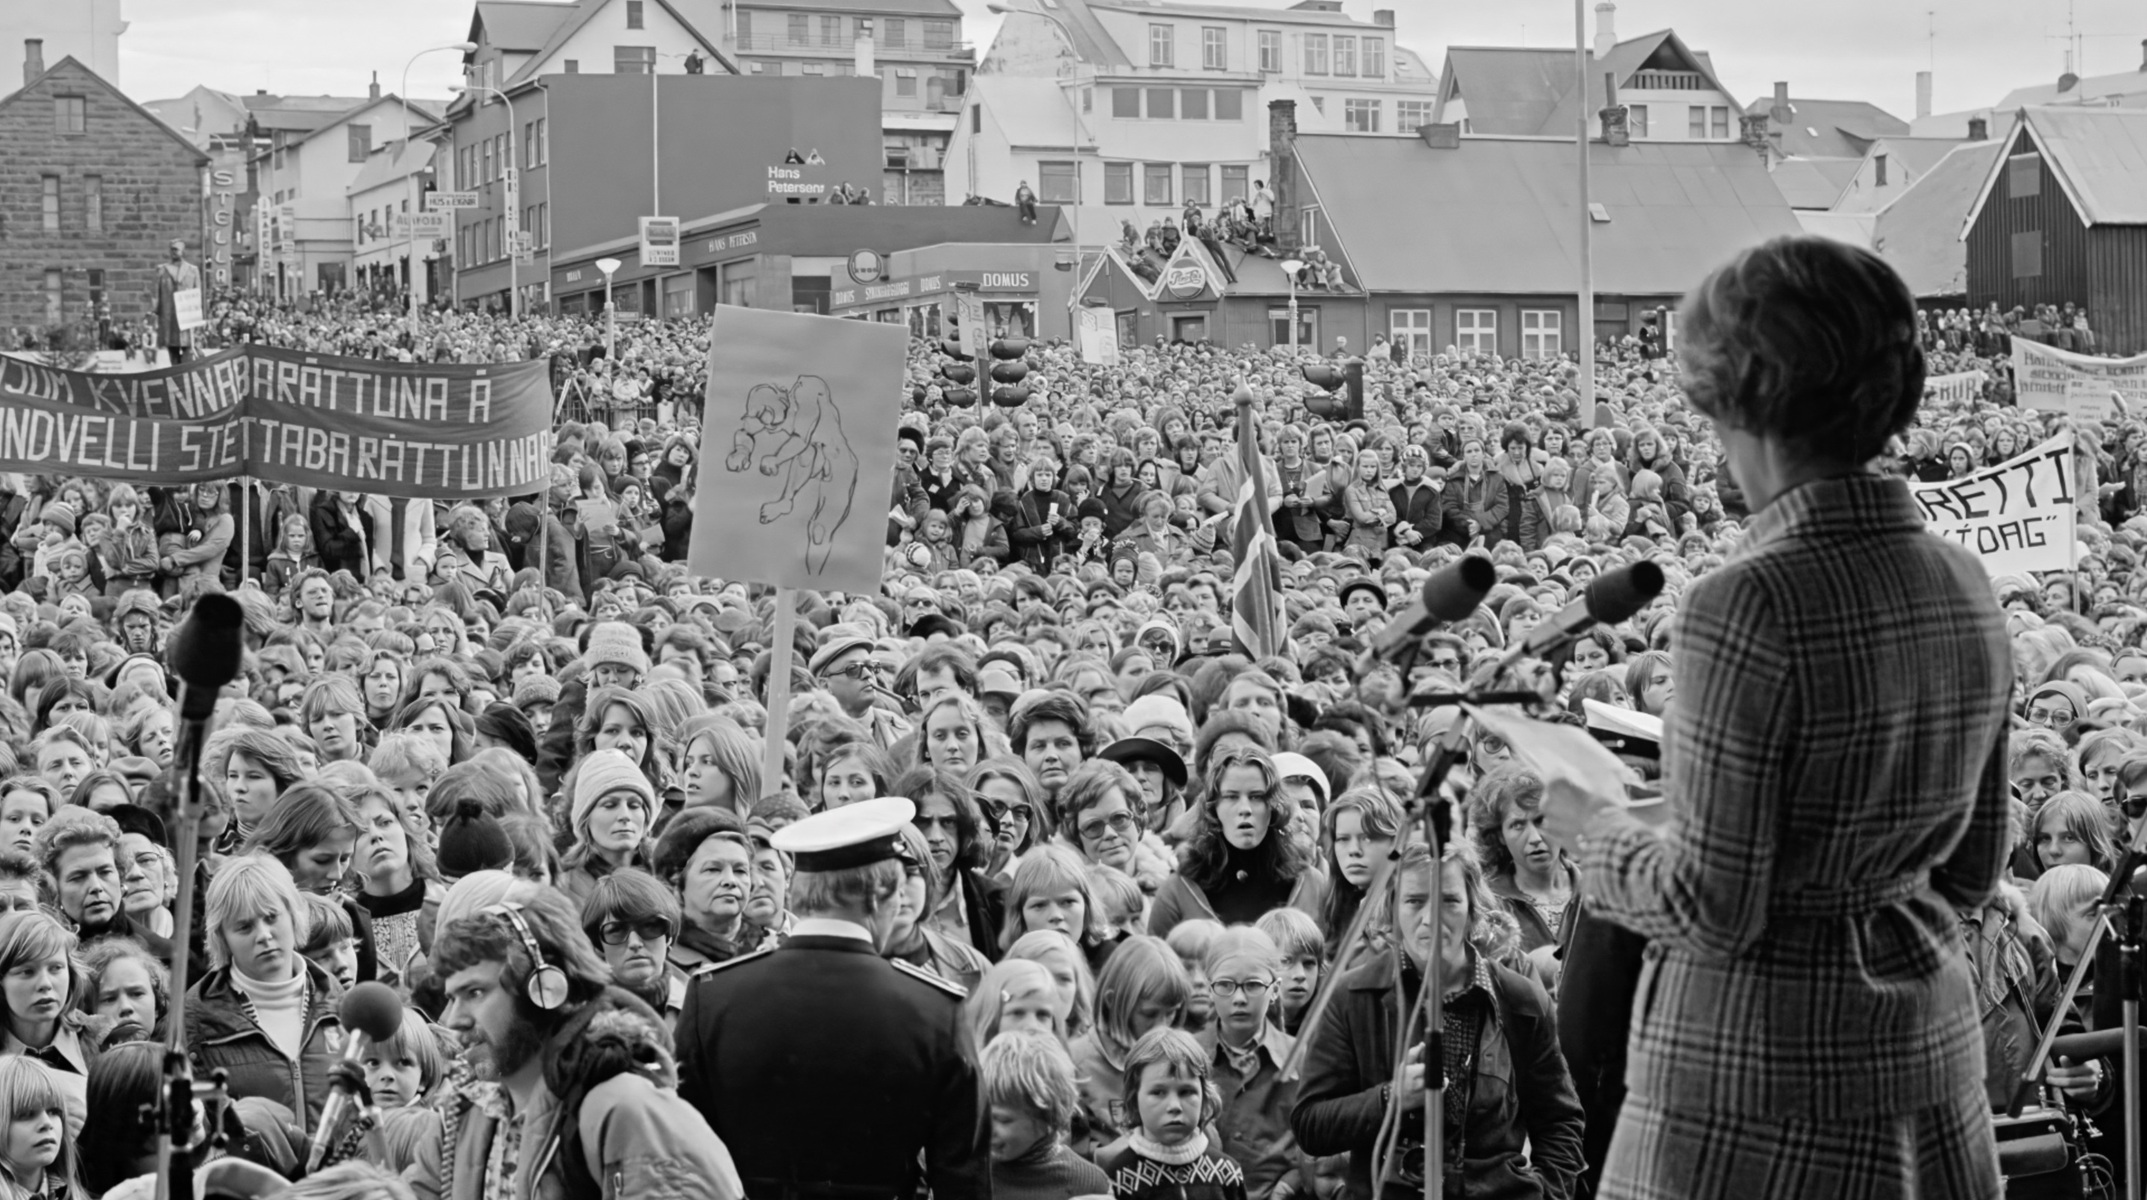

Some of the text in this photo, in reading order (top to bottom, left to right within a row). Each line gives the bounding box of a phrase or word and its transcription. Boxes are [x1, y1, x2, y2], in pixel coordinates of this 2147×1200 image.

[767, 166, 801, 179] Hans
[982, 272, 1030, 288] DOMUS
[86, 355, 448, 420] KVENNABARÁTTUNA
[468, 368, 492, 423] Á
[0, 407, 160, 472] NDVELLI
